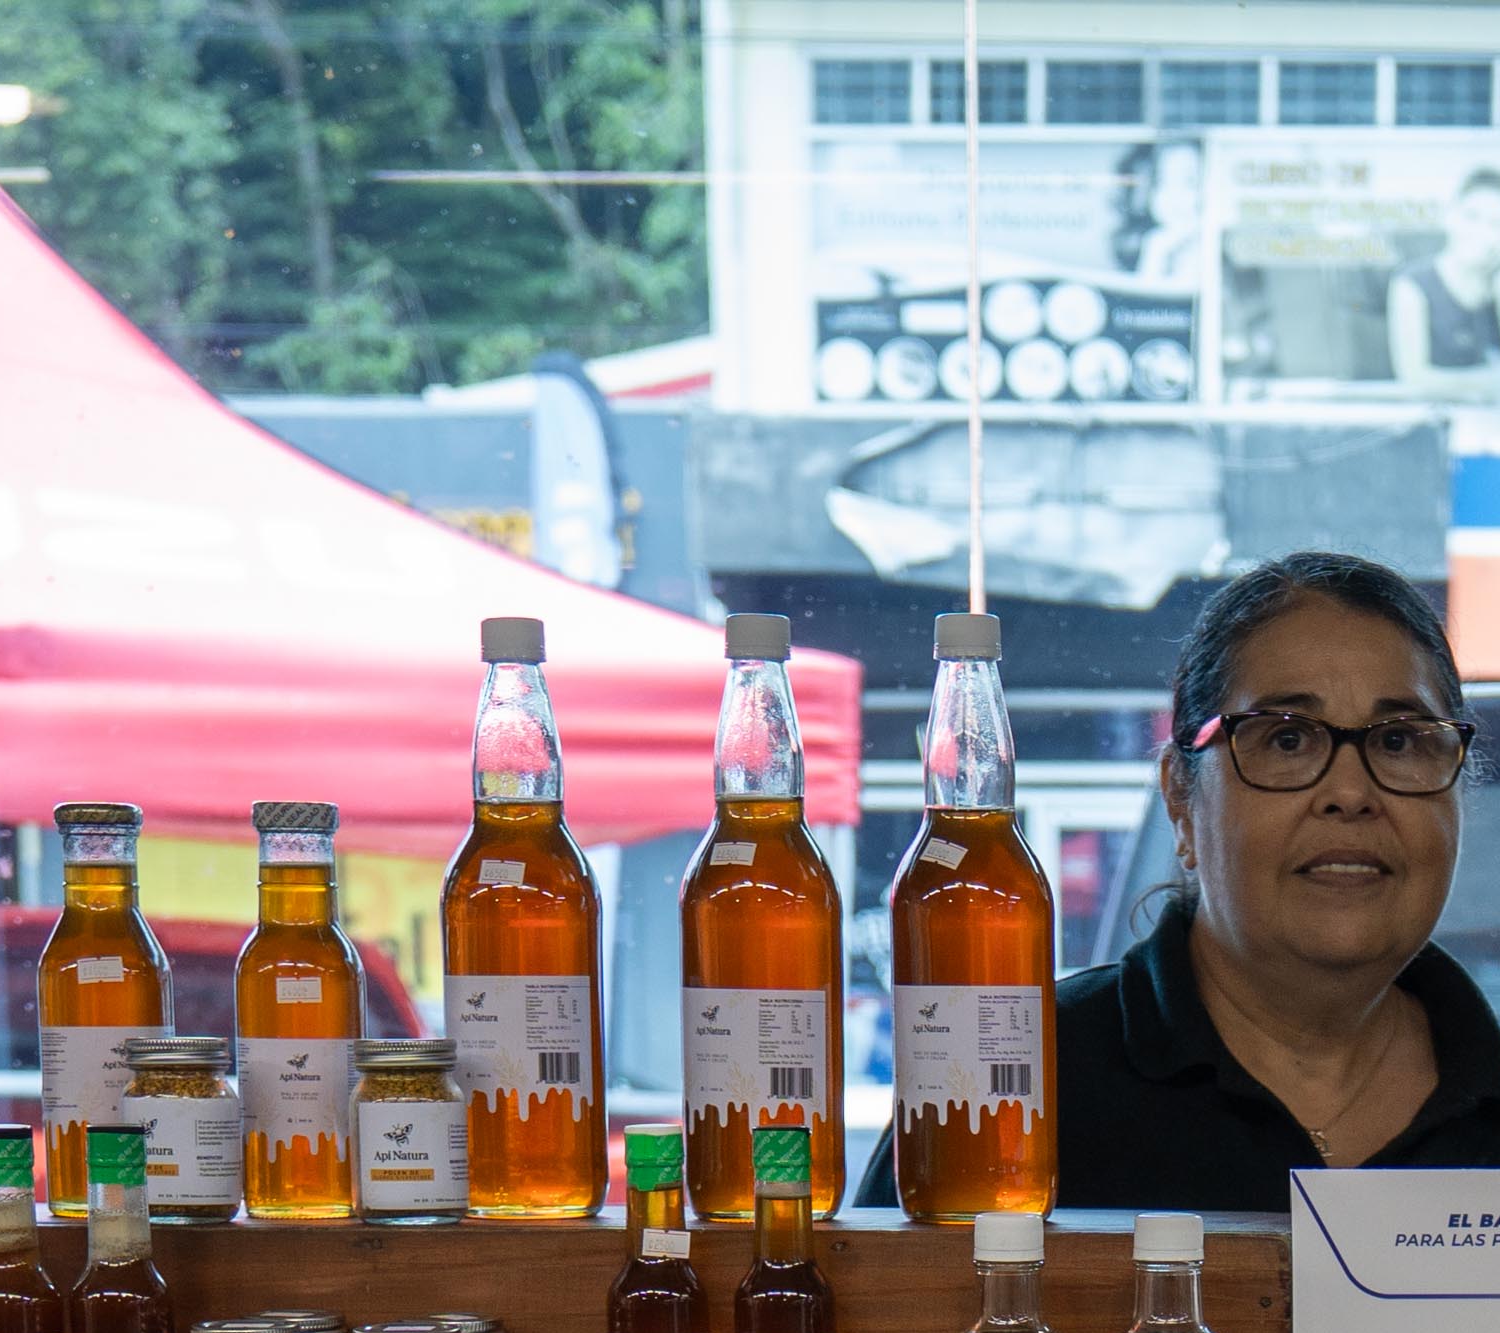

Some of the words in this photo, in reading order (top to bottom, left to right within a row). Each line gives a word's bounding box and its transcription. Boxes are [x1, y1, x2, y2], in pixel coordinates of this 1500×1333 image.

[1448, 1214, 1474, 1228] EL
[1394, 1234, 1445, 1247] PARA
[1451, 1233, 1486, 1247] LAS
